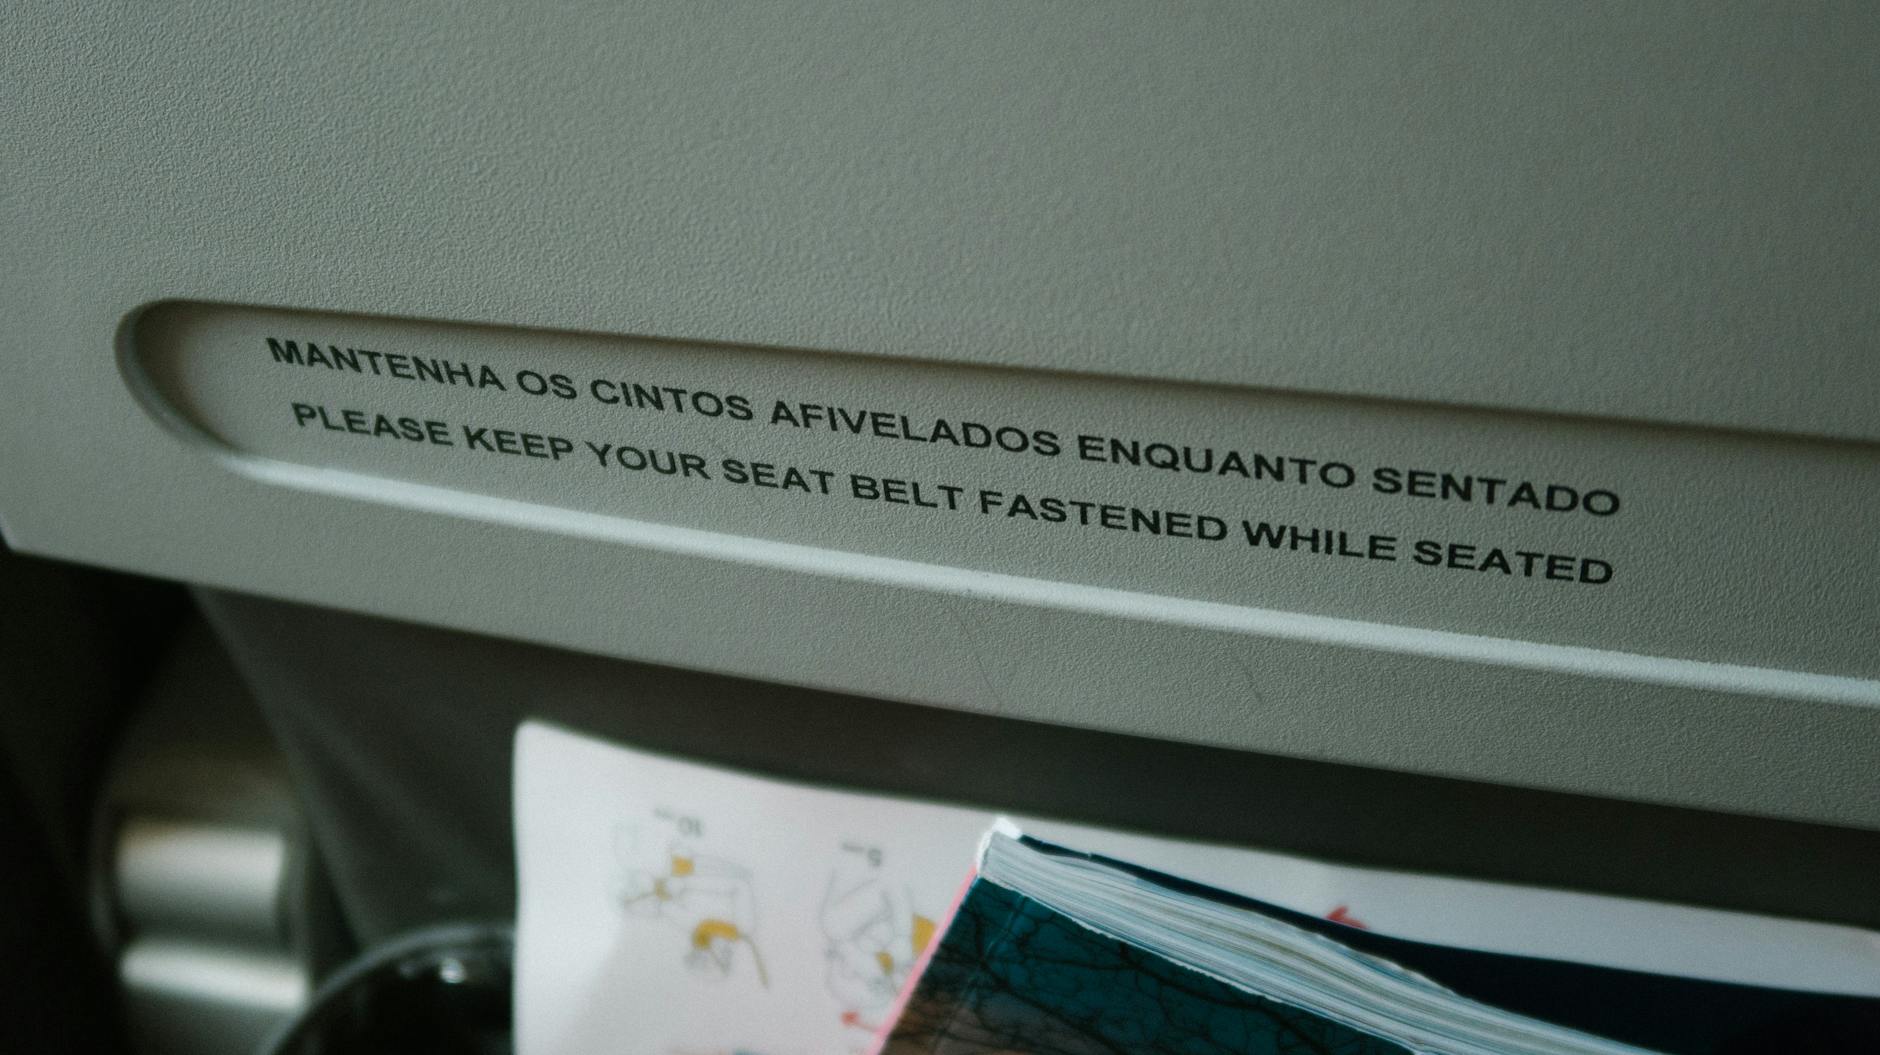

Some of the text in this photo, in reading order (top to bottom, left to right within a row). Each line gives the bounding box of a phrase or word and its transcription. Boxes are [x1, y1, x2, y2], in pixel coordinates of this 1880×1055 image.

[266, 337, 1620, 517] MANTENHA OS CINTOS AFIVELADOS ENQUANTO SENTADO
[292, 403, 1614, 585] PLEASE KEEP YOUR SEAT BELT FASTENED WHILE SEATED
